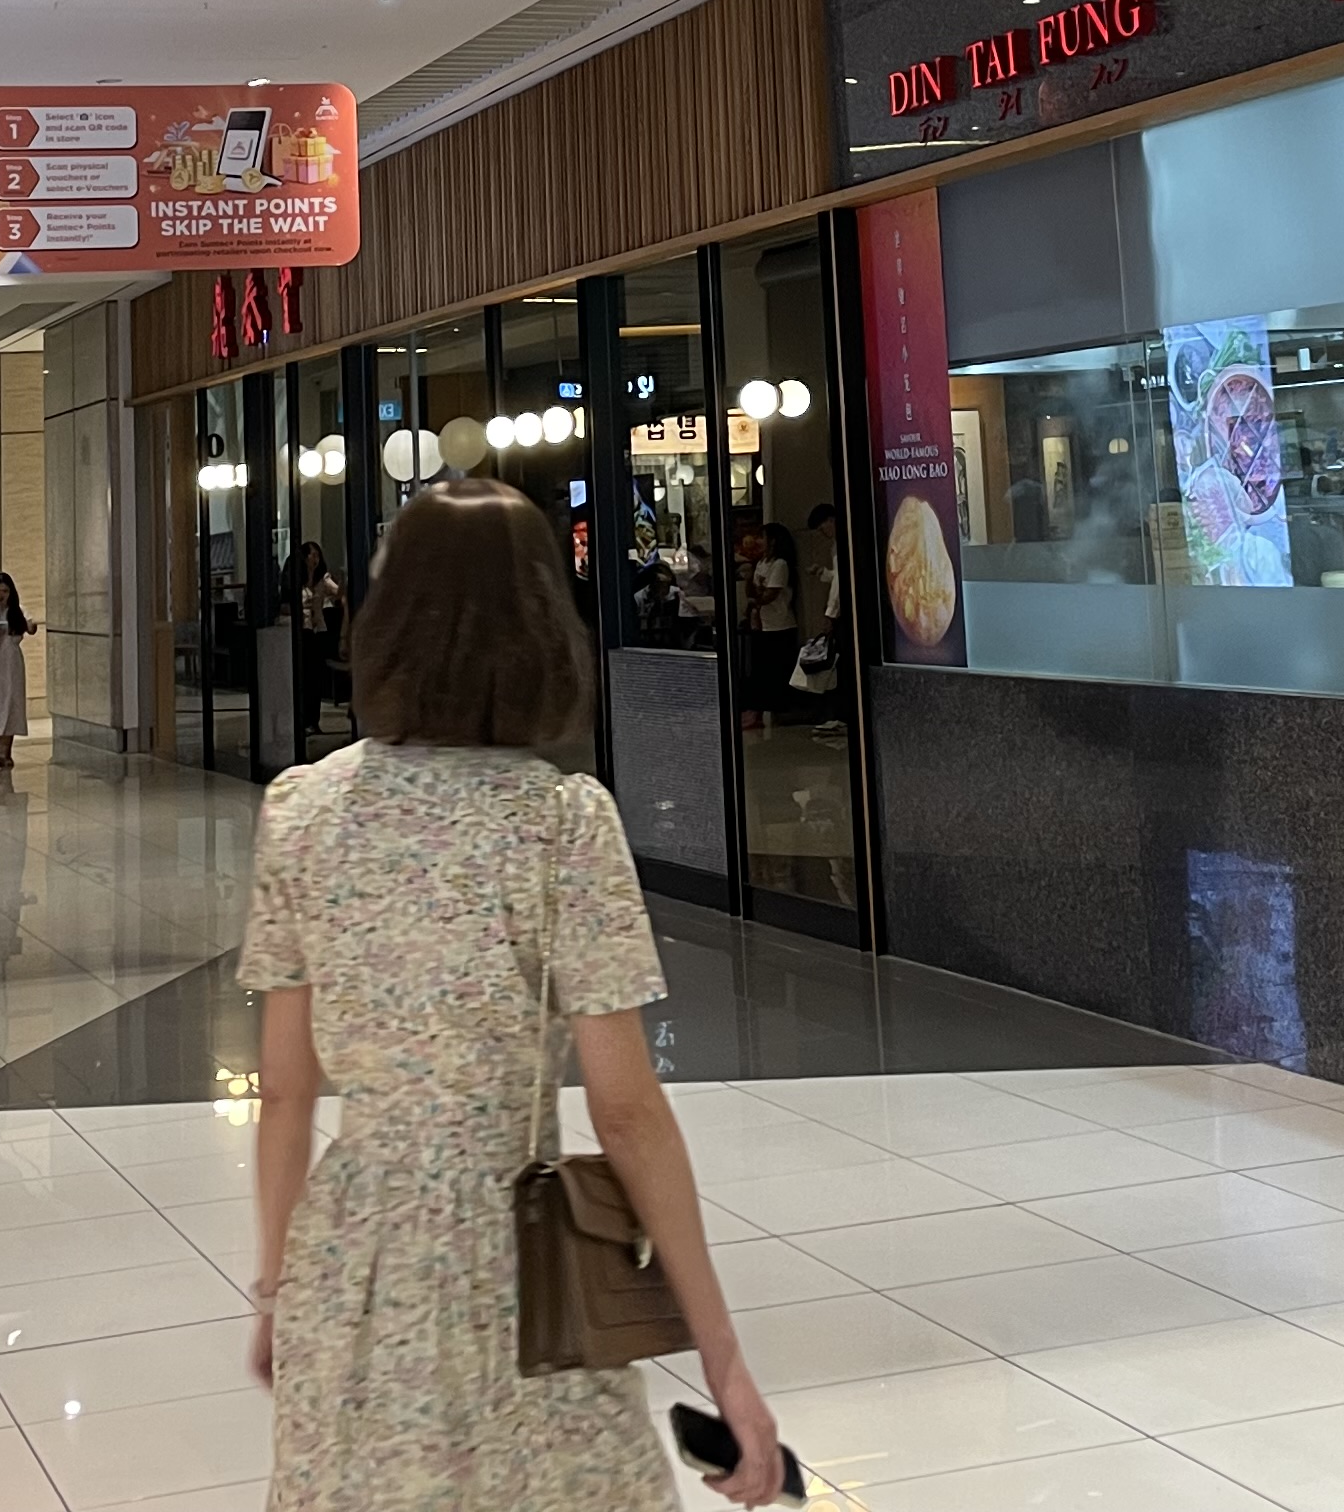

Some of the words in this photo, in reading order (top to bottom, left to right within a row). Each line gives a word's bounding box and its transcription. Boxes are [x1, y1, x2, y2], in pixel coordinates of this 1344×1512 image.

[889, 56, 942, 116] DIN
[965, 31, 1019, 88] TAI
[9, 123, 18, 139] 1
[88, 122, 104, 132] QR
[8, 173, 21, 189] 2
[150, 200, 248, 218] INSTANT
[255, 197, 338, 215] POINTS
[8, 224, 21, 240] 3
[161, 219, 212, 236] SKIP
[219, 218, 263, 235] THE
[270, 216, 329, 233] WAIT
[878, 465, 901, 482] XIAO
[902, 463, 927, 480] LONG
[929, 461, 949, 478] BAO
